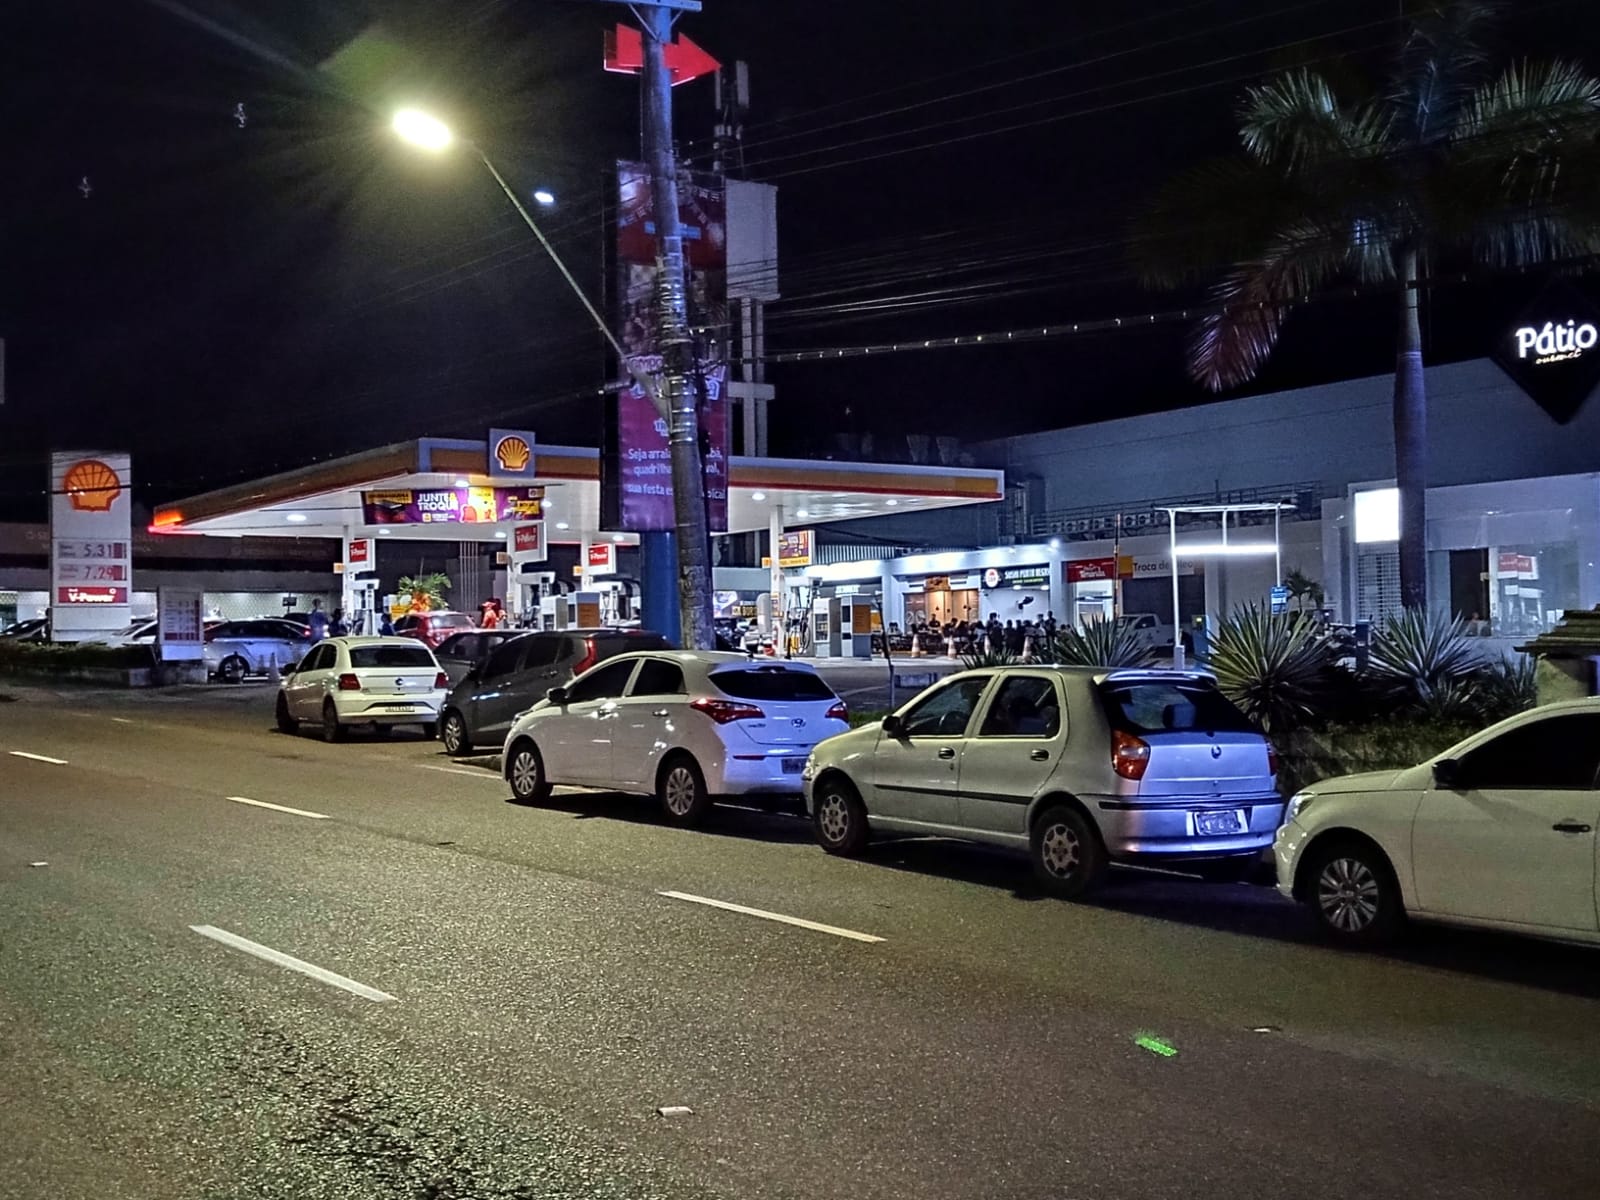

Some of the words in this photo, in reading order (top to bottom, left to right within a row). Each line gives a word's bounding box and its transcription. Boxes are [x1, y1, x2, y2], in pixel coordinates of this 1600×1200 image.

[1514, 319, 1598, 358] Pátio
[628, 448, 647, 461] Seja
[643, 483, 665, 495] festa
[1133, 562, 1157, 572] Troca
